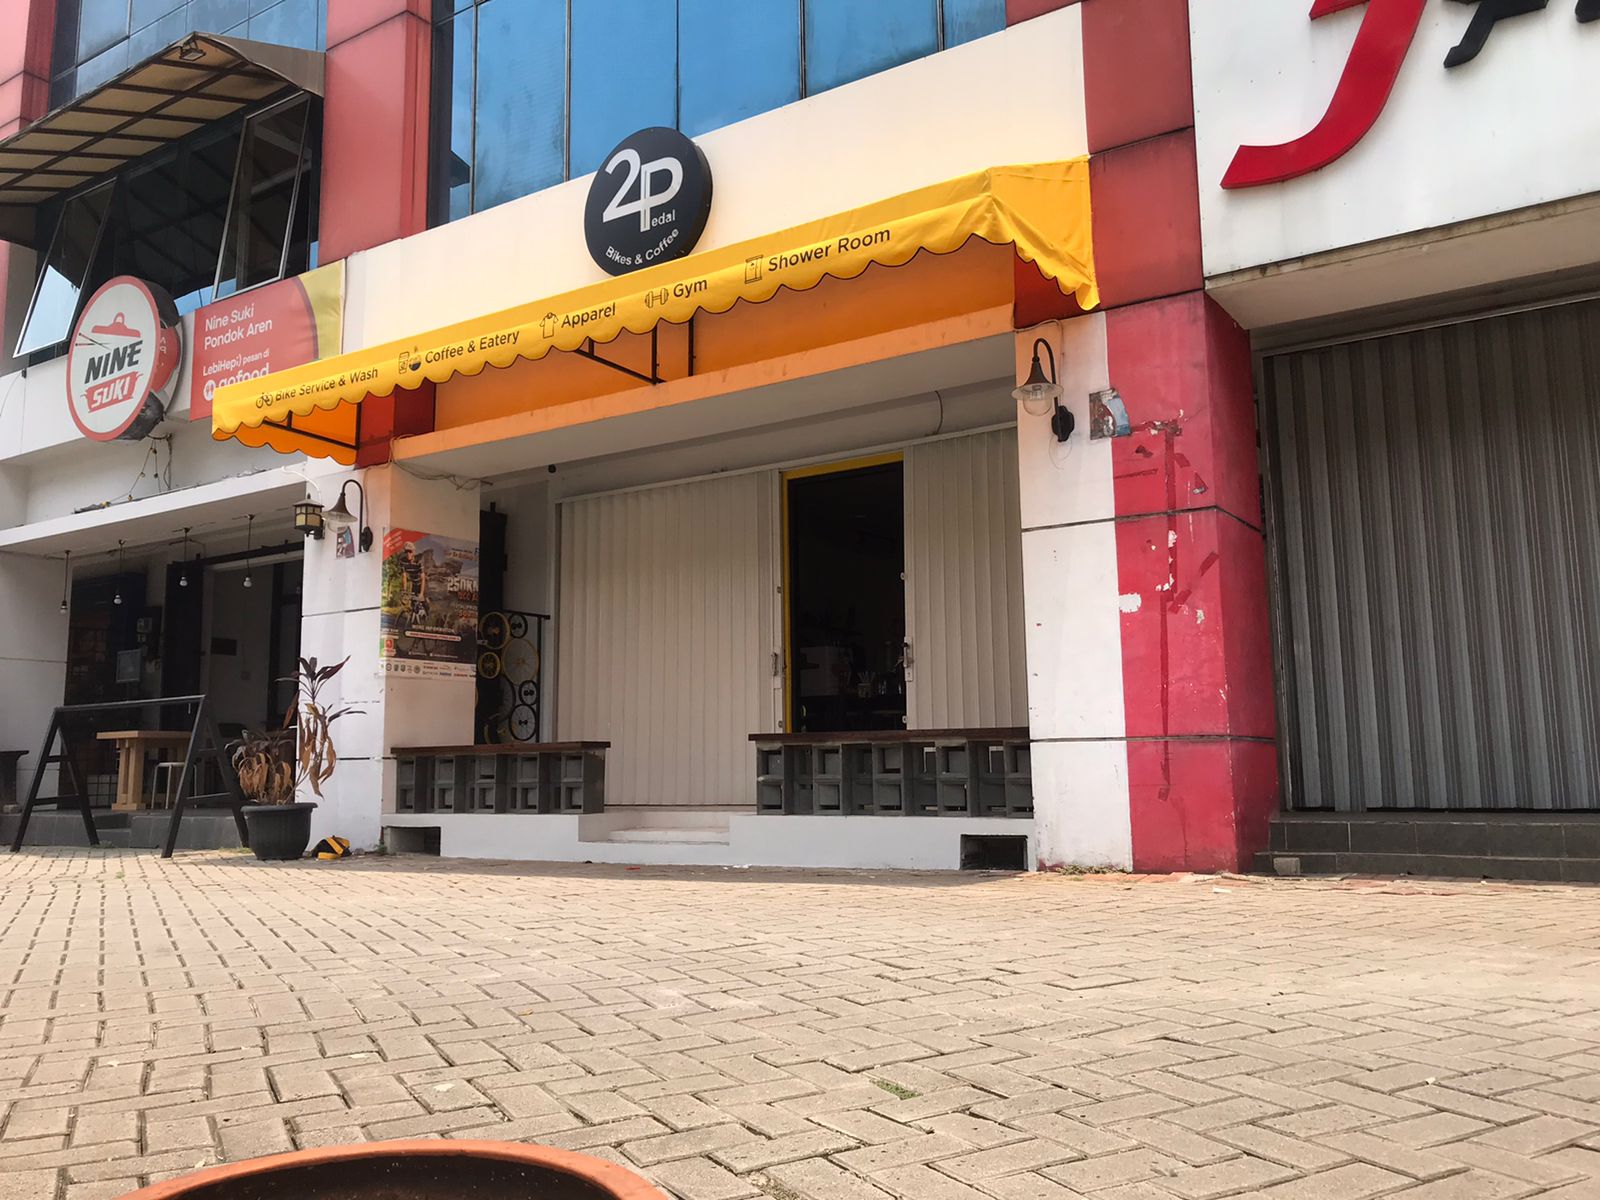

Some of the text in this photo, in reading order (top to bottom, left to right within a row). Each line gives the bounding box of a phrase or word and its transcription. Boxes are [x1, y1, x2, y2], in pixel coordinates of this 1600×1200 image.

[605, 228, 679, 266] Bikes & Coffee
[768, 228, 891, 273] Shower Room
[672, 277, 708, 299] Gym
[205, 303, 255, 332] Nine Suki
[561, 302, 616, 329] Apparel
[204, 320, 273, 350] Pondok Aren
[425, 330, 520, 364] Coffee & Eatery
[85, 340, 143, 384] NINE
[263, 348, 270, 357] di
[91, 376, 131, 409] SUKI
[275, 367, 378, 402] Bike Service & Wash
